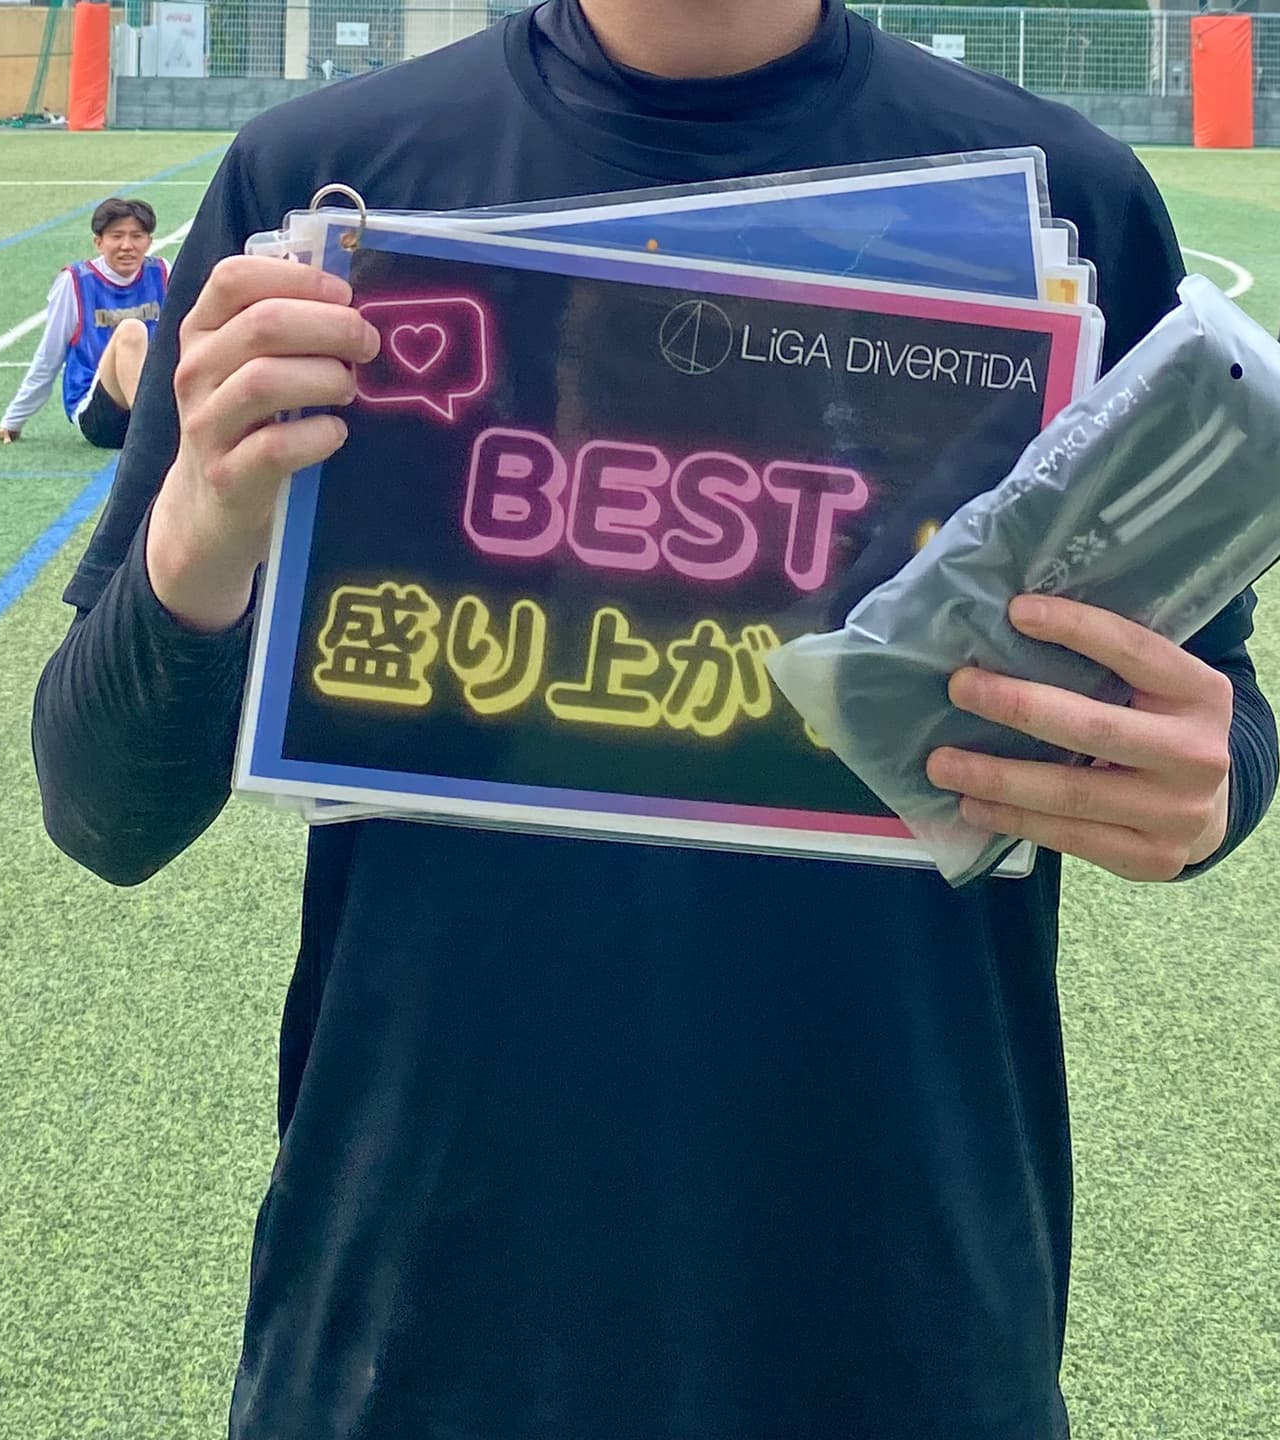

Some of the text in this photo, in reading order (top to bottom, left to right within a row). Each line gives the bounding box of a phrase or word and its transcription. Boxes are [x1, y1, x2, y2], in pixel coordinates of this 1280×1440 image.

[463, 426, 870, 592] BEST
[313, 581, 832, 748] 盛り上が
